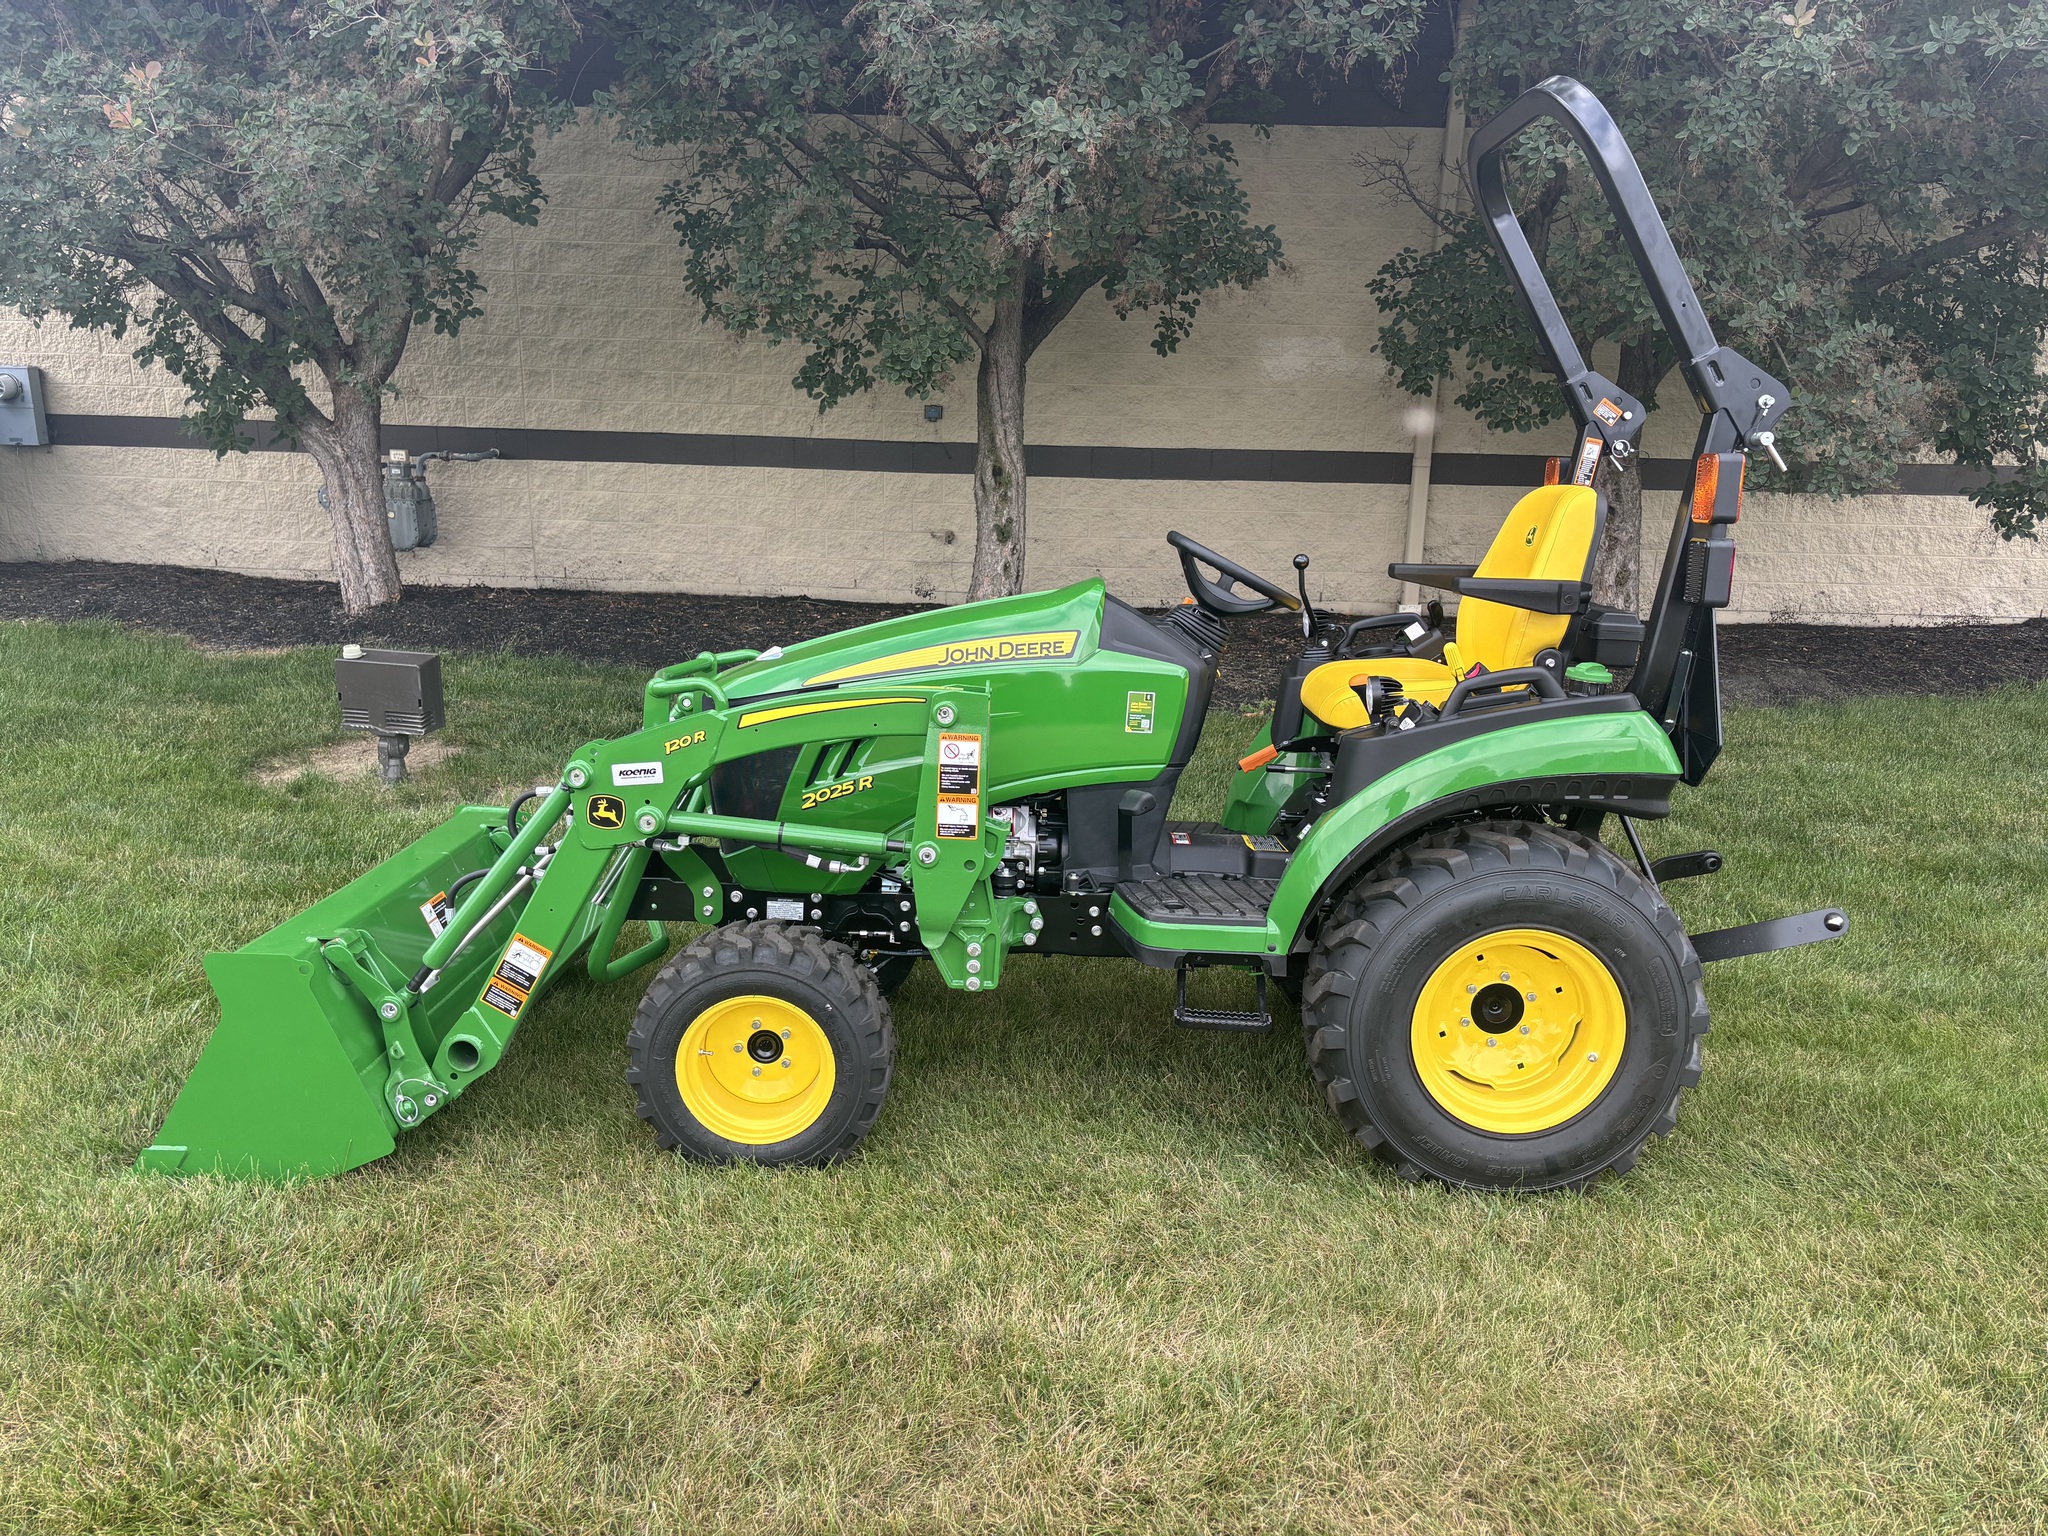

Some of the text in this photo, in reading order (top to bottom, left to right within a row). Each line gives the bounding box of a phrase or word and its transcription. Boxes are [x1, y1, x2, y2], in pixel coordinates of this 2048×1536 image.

[938, 641, 1064, 664] JOHN DEERE
[664, 730, 706, 755] 120 R
[801, 775, 874, 809] 2025 R
[1501, 885, 1628, 932] CARLSTAR
[524, 938, 547, 956] WARNING
